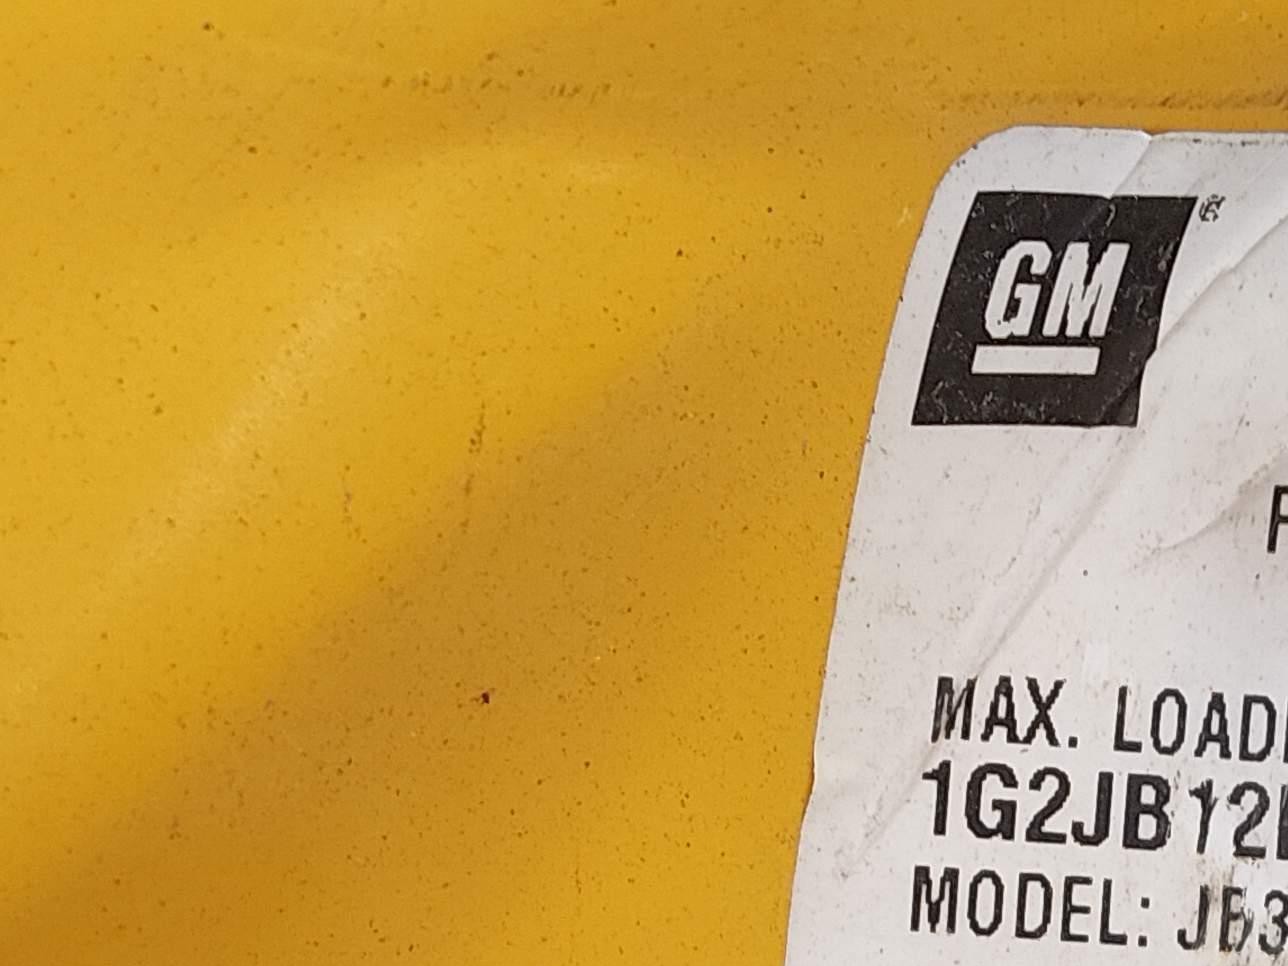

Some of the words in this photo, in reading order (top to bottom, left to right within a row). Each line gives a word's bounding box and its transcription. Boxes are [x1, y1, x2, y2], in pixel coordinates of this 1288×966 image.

[984, 239, 1131, 340] GM
[931, 676, 1079, 749] MAX.
[910, 865, 1150, 947] MODEL:
